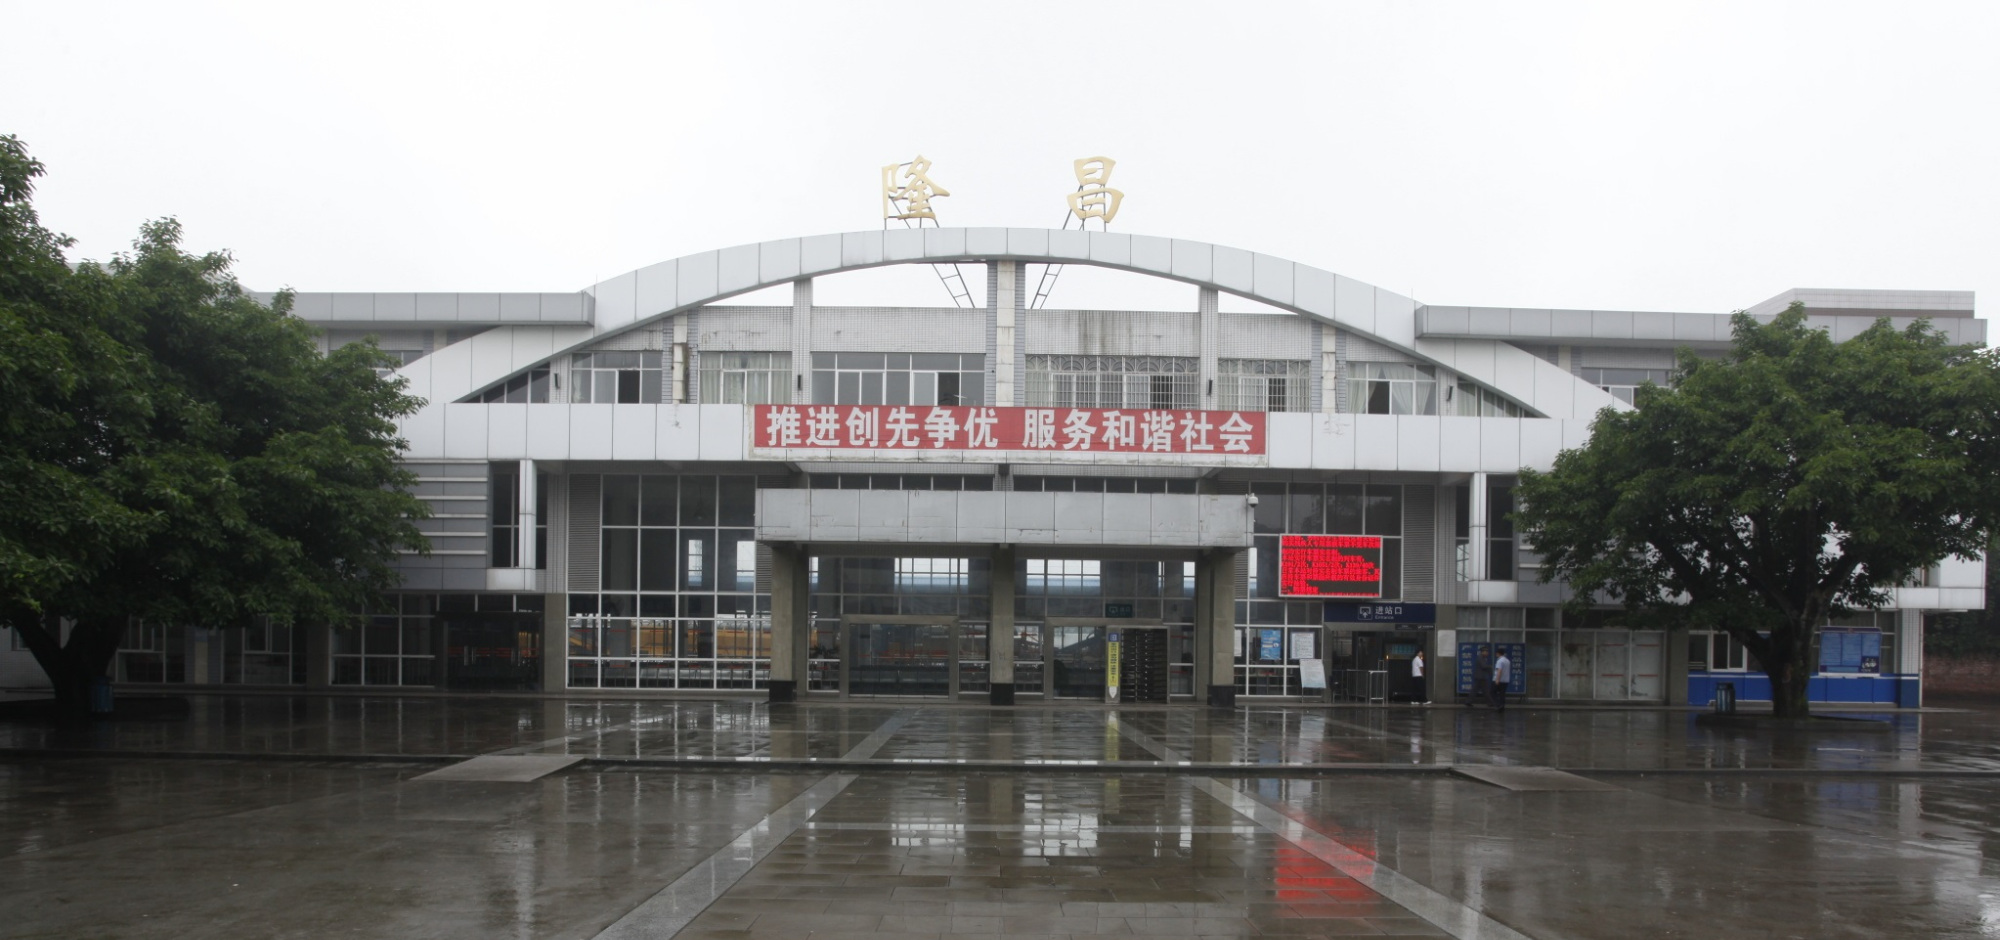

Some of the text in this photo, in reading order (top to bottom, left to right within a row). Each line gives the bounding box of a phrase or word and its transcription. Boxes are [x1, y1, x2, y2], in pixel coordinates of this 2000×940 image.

[766, 406, 1254, 453] 推进创先争优 服务和谐社会
[1375, 606, 1402, 615] 进站口
